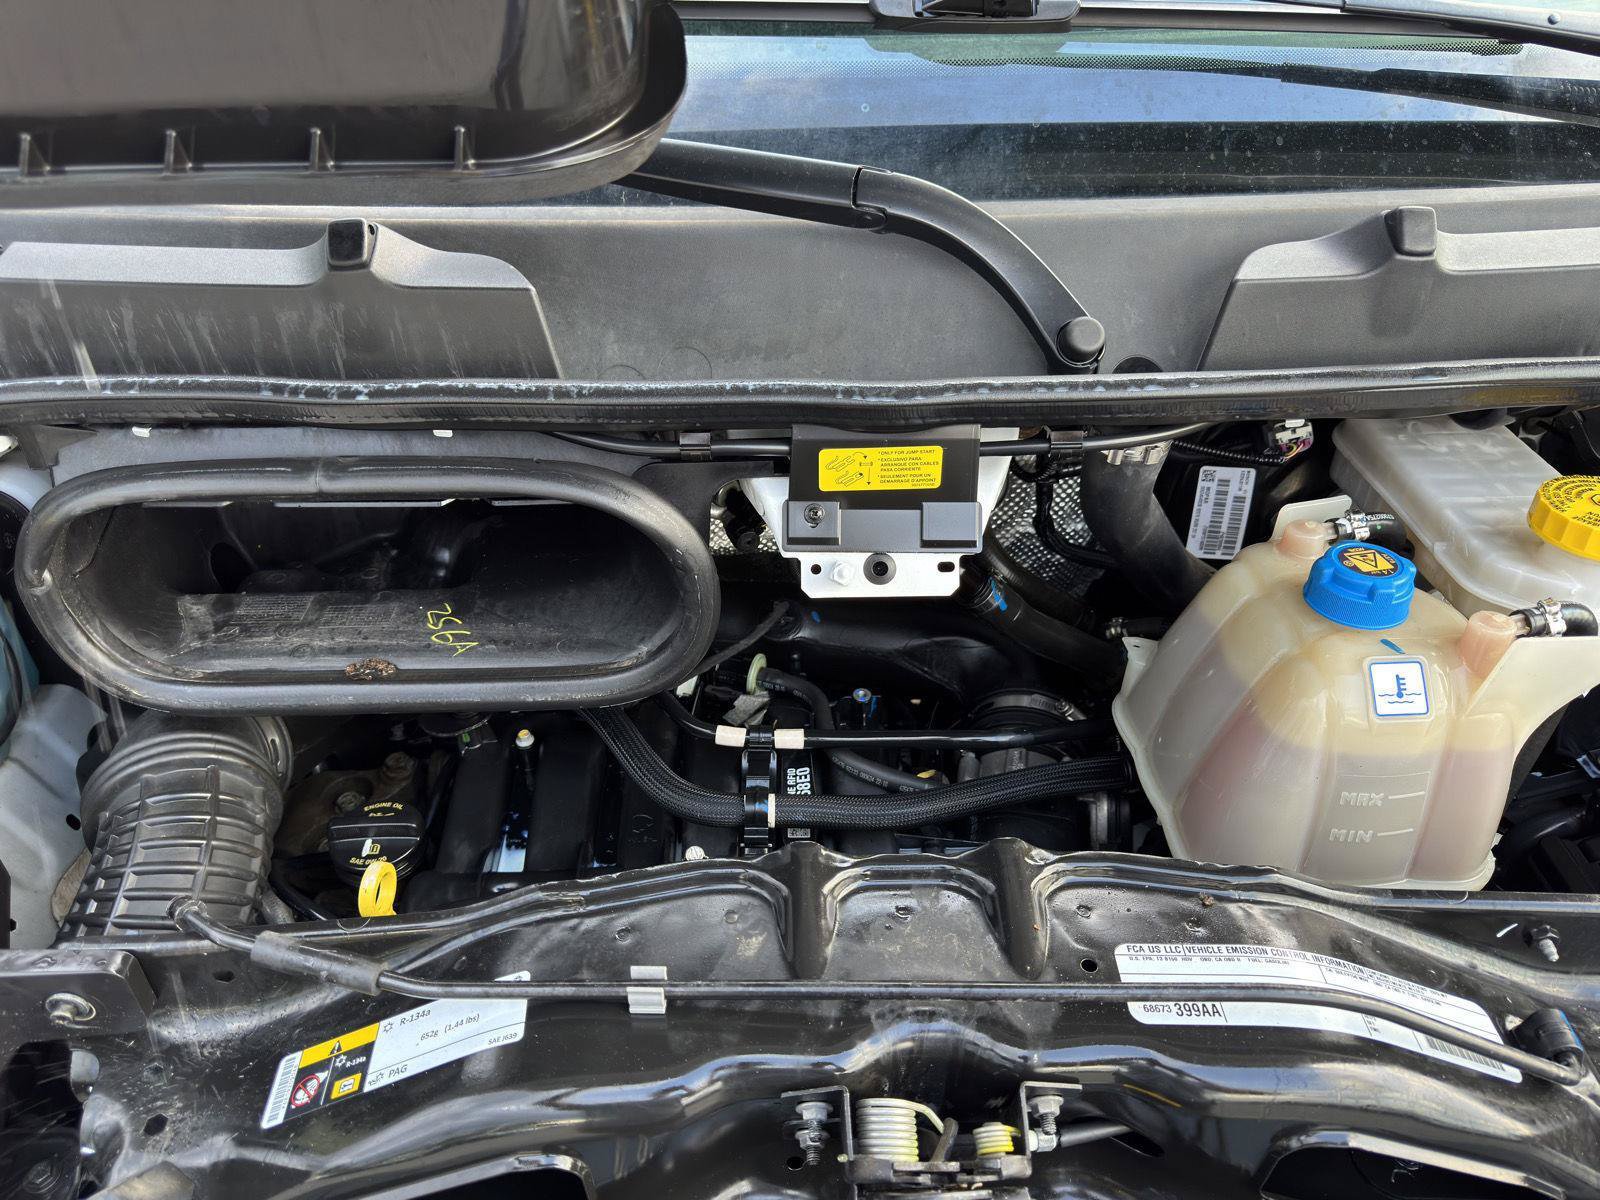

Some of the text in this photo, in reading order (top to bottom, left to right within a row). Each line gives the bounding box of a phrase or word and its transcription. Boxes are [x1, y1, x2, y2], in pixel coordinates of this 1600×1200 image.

[787, 768, 796, 785] RFID
[364, 802, 392, 811] ENGINE
[1340, 791, 1384, 807] MAX
[1329, 828, 1374, 843] MIN
[1147, 945, 1161, 953] US
[1185, 946, 1224, 954] VEHICLE
[1226, 946, 1269, 956] EMISSION
[1270, 948, 1310, 961] CONTROL
[1311, 953, 1365, 976] INFORMATION
[399, 1008, 432, 1026] R-134a
[1143, 1002, 1222, 1018] 68673 399AA
[420, 1013, 480, 1041] 652g (1.44 lbs)
[487, 1032, 518, 1046] SAE J639
[388, 1064, 408, 1078] PAG
